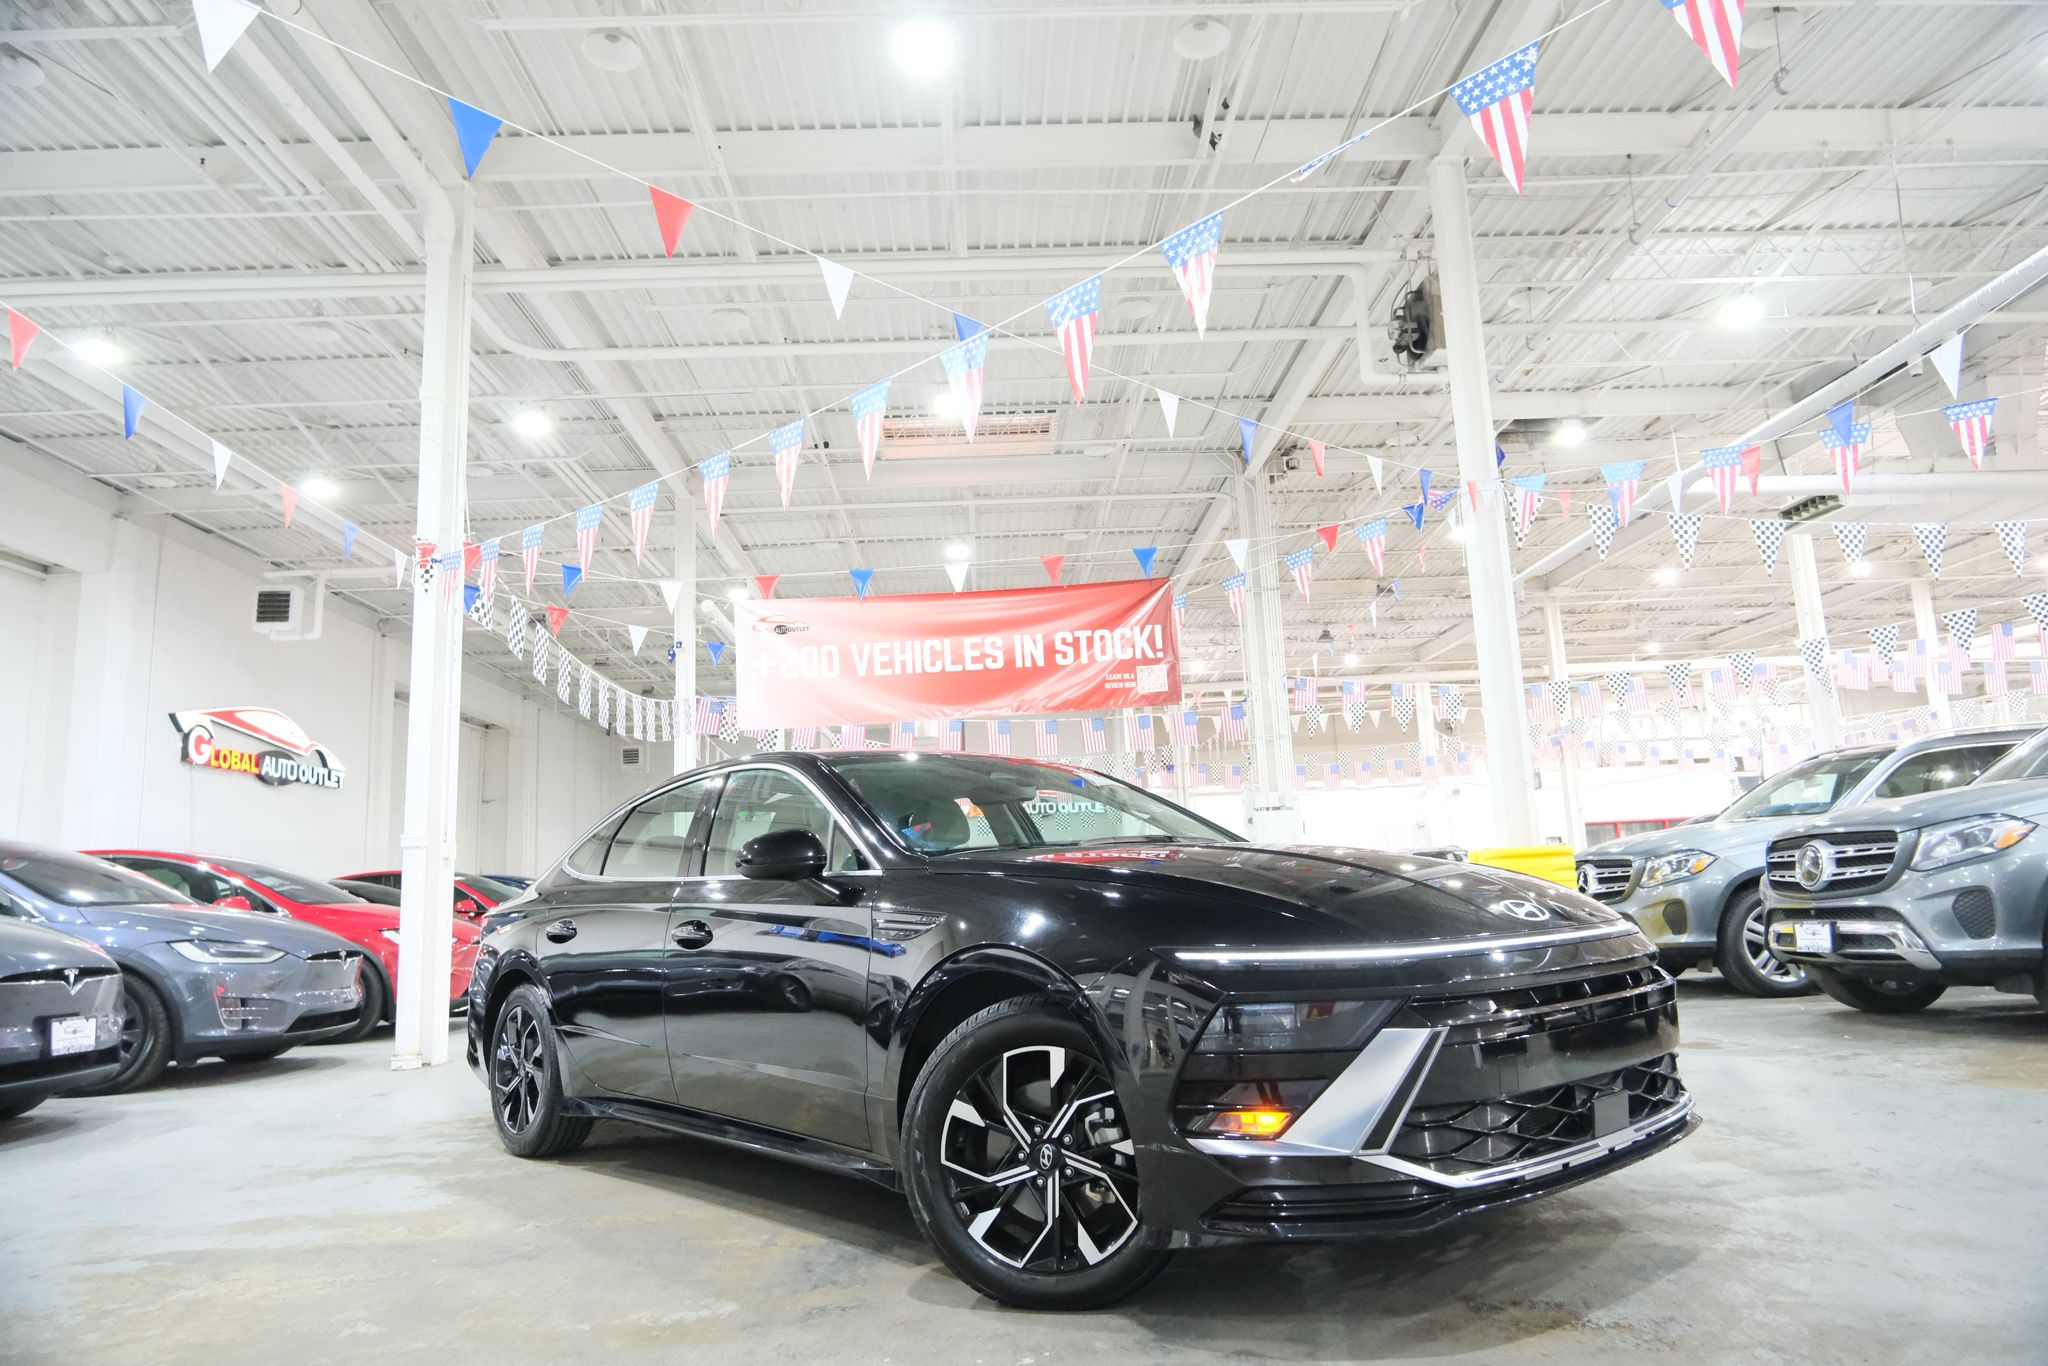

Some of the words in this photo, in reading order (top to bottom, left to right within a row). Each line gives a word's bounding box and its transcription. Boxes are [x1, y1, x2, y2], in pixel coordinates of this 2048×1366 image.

[752, 644, 840, 679] +200
[850, 636, 1005, 677] VEHICLES
[1014, 633, 1045, 668] IN
[1055, 625, 1164, 666] STOCK!
[188, 726, 260, 775] GLOBAL
[262, 755, 298, 781] AUTO
[299, 766, 346, 789] OUTLET
[1058, 802, 1105, 813] OUTLE
